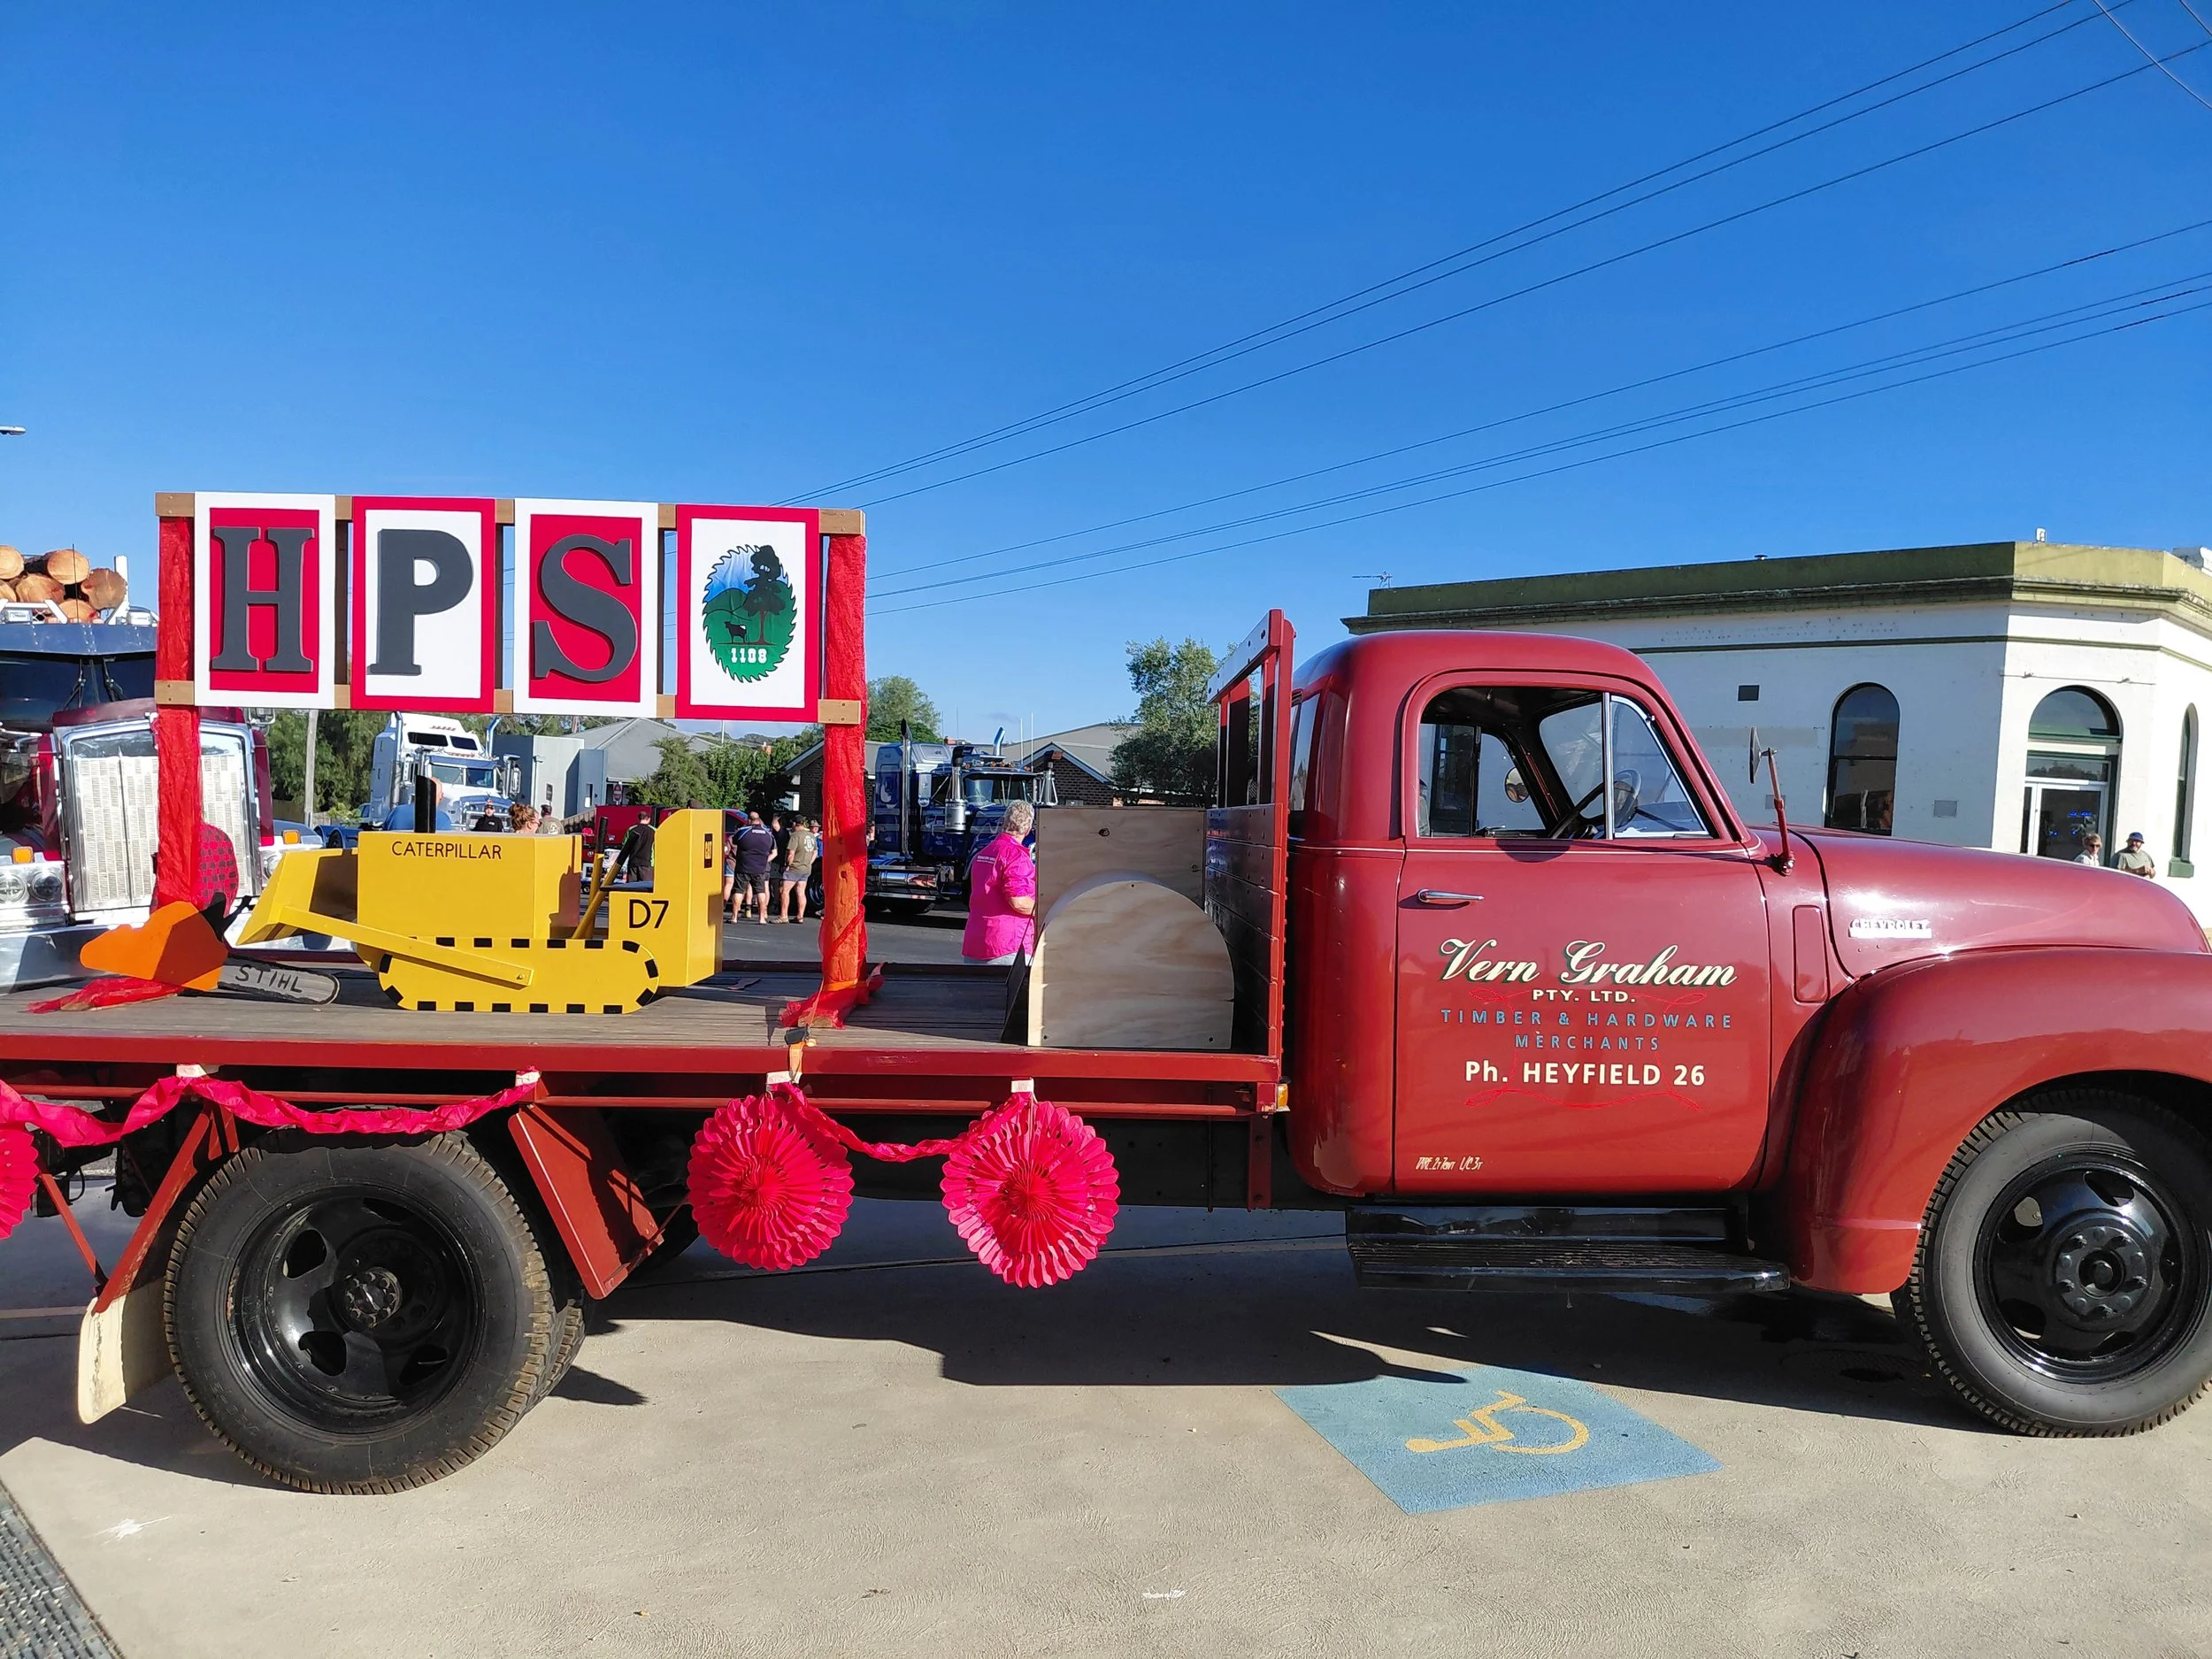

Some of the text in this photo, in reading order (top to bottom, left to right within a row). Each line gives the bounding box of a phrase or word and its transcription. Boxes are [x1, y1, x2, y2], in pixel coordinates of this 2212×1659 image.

[731, 647, 767, 664] 1108
[391, 841, 502, 860] CATERPILLAR
[629, 899, 669, 929] D7
[1440, 938, 1738, 987] Vern Graham
[234, 964, 303, 994] STIHL
[1532, 988, 1636, 1003] PTY. LTD.
[1440, 1009, 1732, 1029] TIMBER & HARDWARE
[1464, 1060, 1706, 1087] Ph. HEYFIELD 26
